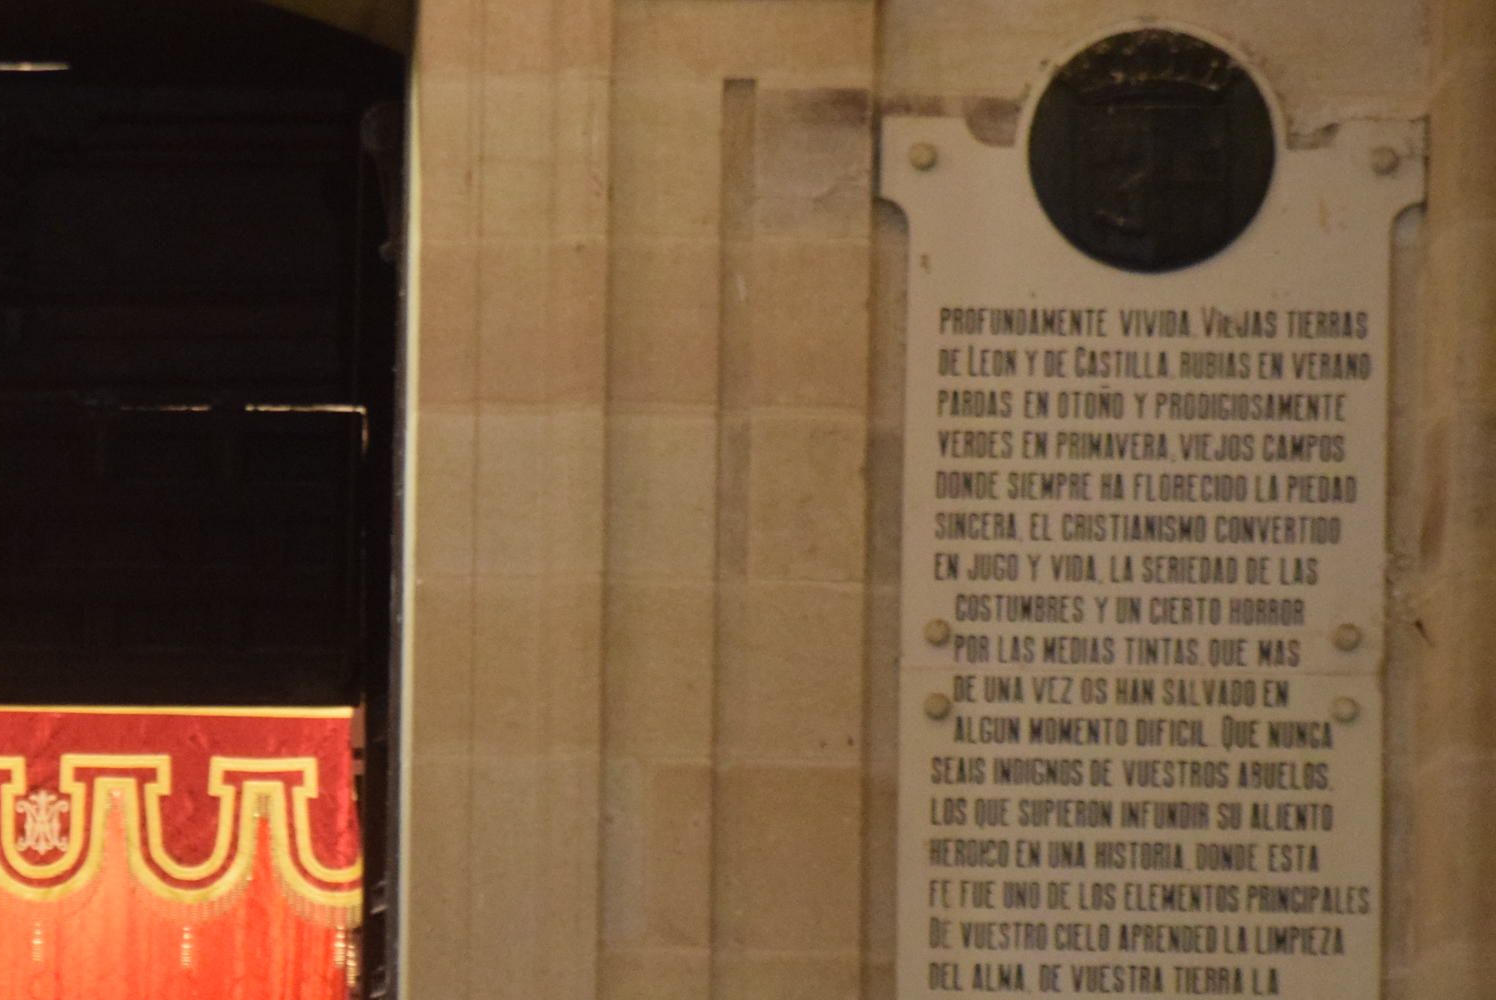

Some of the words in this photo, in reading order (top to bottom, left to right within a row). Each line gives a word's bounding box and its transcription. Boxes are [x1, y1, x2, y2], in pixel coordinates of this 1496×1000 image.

[938, 307, 1107, 338] PROFUNDAMENTE
[1286, 311, 1369, 341] TIERRAS
[937, 348, 961, 377] DE
[1025, 349, 1037, 378] Y
[1042, 349, 1067, 378] DE
[1179, 351, 1252, 380] RUBIAS
[1257, 352, 1285, 381] EN
[1290, 352, 1373, 382] VERANO
[936, 390, 1013, 419] PARDAS
[1022, 391, 1050, 420] EN
[1056, 386, 1125, 421] OTOÑO
[1134, 392, 1146, 421] Y
[1154, 392, 1346, 424] PRODIGIOSAMENTE
[936, 430, 1014, 459] VERDES
[1021, 431, 1049, 460] EN
[1178, 433, 1256, 463] VIEJOS
[1261, 434, 1346, 464] CAMPOS
[934, 470, 999, 499] DONDE
[1007, 470, 1091, 500] SIEMPRE
[1099, 472, 1125, 501] HA
[1132, 472, 1249, 502] FLORECIDO
[1253, 474, 1280, 503] LA
[1285, 474, 1358, 504] PIEDAD
[1028, 513, 1052, 542] EL
[1060, 513, 1208, 544] CRISTIANISMO
[1213, 515, 1342, 546] CONVERTIDO
[933, 552, 961, 582] EN
[967, 553, 1020, 583] JUGO
[1028, 554, 1039, 583] Y
[1109, 555, 1134, 584] LA
[1141, 555, 1239, 585] SERIEDAD
[1244, 556, 1270, 586] DE
[1278, 557, 1319, 586] LAS
[953, 594, 1085, 624] COSTUMBRES
[1095, 596, 1107, 625] Y
[1114, 596, 1143, 625] UN
[1148, 596, 1223, 626] CIERTO
[1228, 597, 1306, 627] HORROR
[951, 634, 991, 663] POR
[996, 634, 1036, 664] LAS
[1041, 635, 1116, 665] MEDIAS
[1207, 637, 1247, 668] QUE
[951, 676, 976, 705] DE
[983, 676, 1025, 706] UNA
[1031, 677, 1072, 706] VEZ
[1079, 677, 1108, 707] OS
[1114, 678, 1156, 707] HAN
[1162, 678, 1258, 709] SALVADO
[1261, 680, 1291, 709] EN
[953, 715, 1022, 745] ALGUN
[1028, 716, 1129, 746] MOMENTO
[1220, 715, 1259, 750] QUE
[1266, 719, 1334, 748] NUNCA
[930, 755, 987, 785] SEAIS
[992, 756, 1084, 786] INDIGNOS
[1088, 757, 1112, 787] DE
[1121, 758, 1230, 788] VUESTROS
[929, 796, 968, 826] LOS
[973, 797, 1009, 828] QUE
[1017, 798, 1114, 828] SUPIERON
[1119, 799, 1211, 829] INFUNDIR
[1216, 800, 1244, 829] SU
[1249, 800, 1335, 830] ALIENTO
[1014, 839, 1043, 868] EN
[1047, 839, 1087, 868] UNA
[1195, 841, 1258, 871] DONDE
[1266, 842, 1320, 871] ESTA
[928, 879, 951, 909] FE
[959, 880, 994, 909] FUE
[1002, 880, 1042, 910] UNO
[1046, 881, 1070, 910] DE
[1077, 881, 1117, 911] LOS
[1123, 882, 1241, 912] ELEMENTOS
[1245, 883, 1371, 914] PRINCIPALES
[928, 918, 951, 950] DE
[959, 921, 1049, 951] VUESTRO
[1053, 922, 1111, 952] CIELO
[1117, 923, 1219, 953] APRENDED
[1222, 924, 1249, 953] LA
[1253, 924, 1345, 955] LIMPIEZA
[927, 962, 962, 992] DEL
[1038, 964, 1061, 993] DE
[1070, 964, 1164, 994] VUESTRA
[1173, 966, 1245, 995] TIERRA
[1250, 966, 1280, 996] LA
